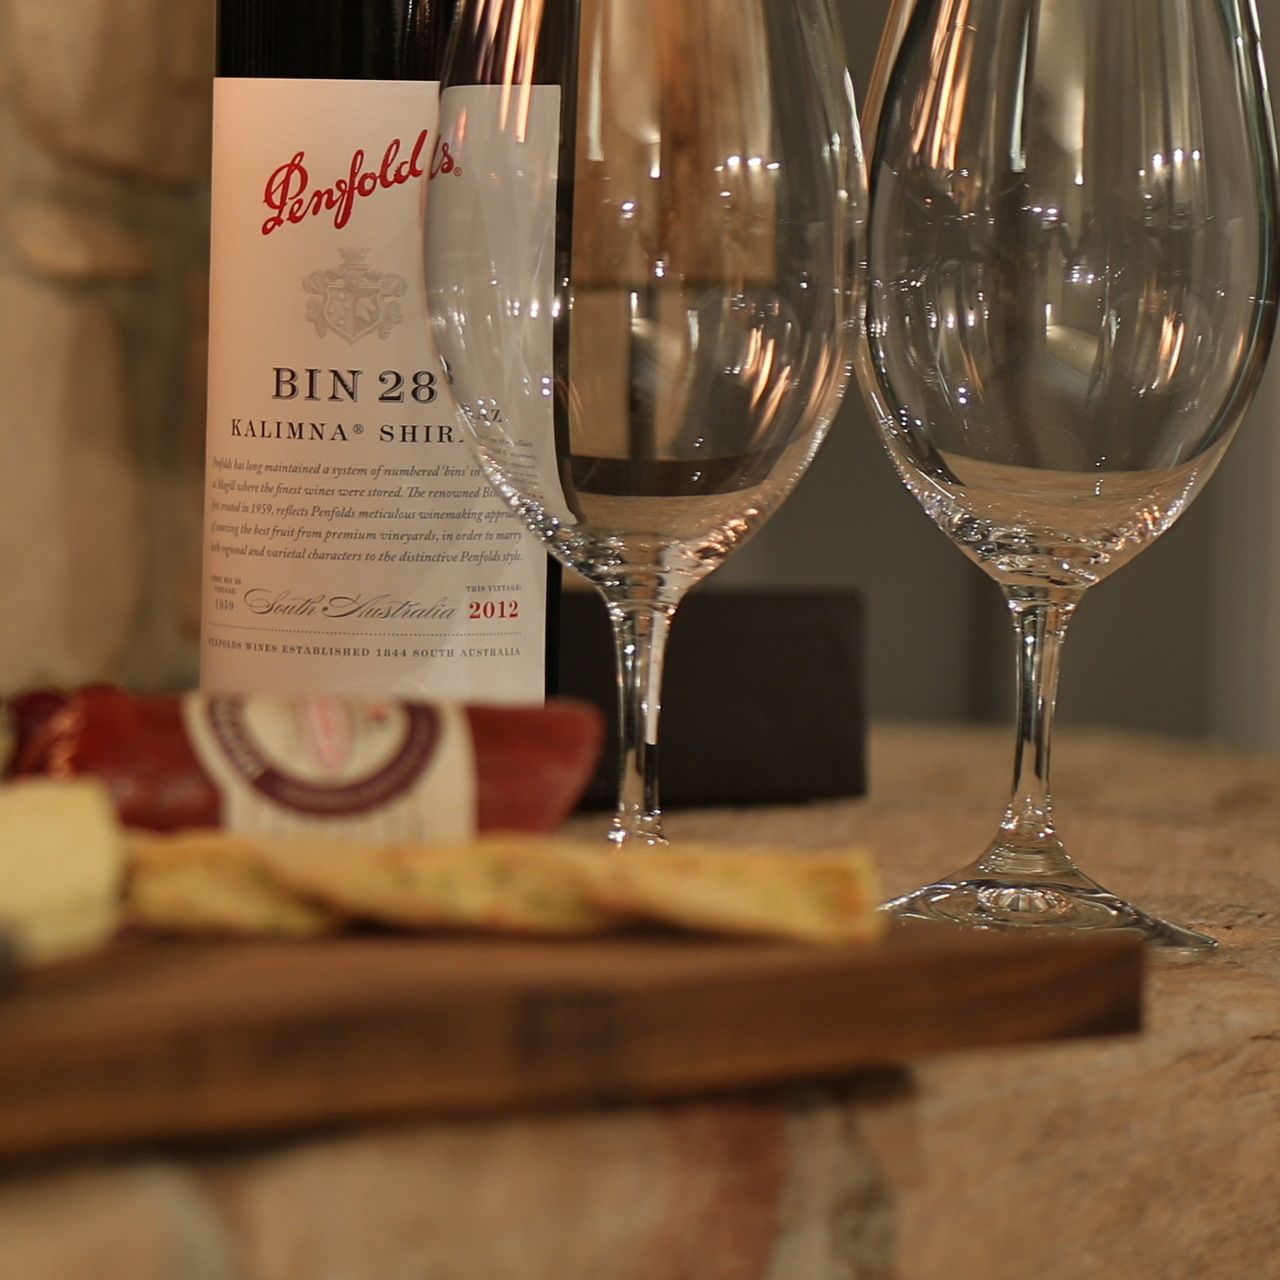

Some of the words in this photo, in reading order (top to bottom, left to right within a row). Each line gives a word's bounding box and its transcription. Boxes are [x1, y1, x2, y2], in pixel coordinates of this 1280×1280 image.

[272, 367, 364, 403] BIN
[378, 370, 438, 404] 28
[246, 459, 262, 475] long
[265, 463, 321, 474] maintained
[322, 466, 329, 474] a
[332, 465, 367, 479] system
[370, 464, 385, 480] of
[385, 466, 439, 477] numbered
[470, 466, 480, 477] in
[261, 482, 274, 494] the
[273, 483, 302, 497] finest
[304, 485, 335, 496] wines
[338, 487, 365, 497] were
[368, 487, 404, 498] stored.
[407, 487, 426, 498] The
[428, 487, 480, 498] renowned
[251, 504, 274, 516] 1959,
[276, 505, 308, 519] reflects
[311, 505, 355, 521] Penfolds
[358, 508, 415, 519] meticulous
[419, 509, 482, 523] winemaking
[240, 523, 252, 535] the
[254, 524, 270, 535] best
[269, 525, 295, 540] fruit
[295, 526, 322, 541] from
[325, 529, 377, 543] premium
[380, 529, 439, 544] vineyards,
[442, 530, 453, 541] in
[456, 530, 482, 541] order
[485, 531, 493, 541] to
[496, 532, 522, 543] marry
[248, 546, 266, 557] and
[267, 548, 305, 559] varietal
[308, 549, 361, 561] characters
[365, 552, 376, 562] to
[379, 551, 397, 562] the
[399, 551, 457, 562] distinctive
[460, 551, 502, 566] Penfolds
[503, 550, 523, 565] style.
[466, 585, 485, 593] THIS
[215, 598, 234, 611] 1959
[244, 588, 326, 616] South
[322, 593, 456, 618] Australia
[469, 600, 519, 619] 2012
[208, 637, 241, 650] PENFOLDS
[246, 642, 277, 653] WINES
[282, 645, 370, 657] ESTABLISHED
[376, 648, 407, 658] 1844
[412, 648, 454, 658] SOUTH
[460, 648, 521, 657] AUSTRALIA
